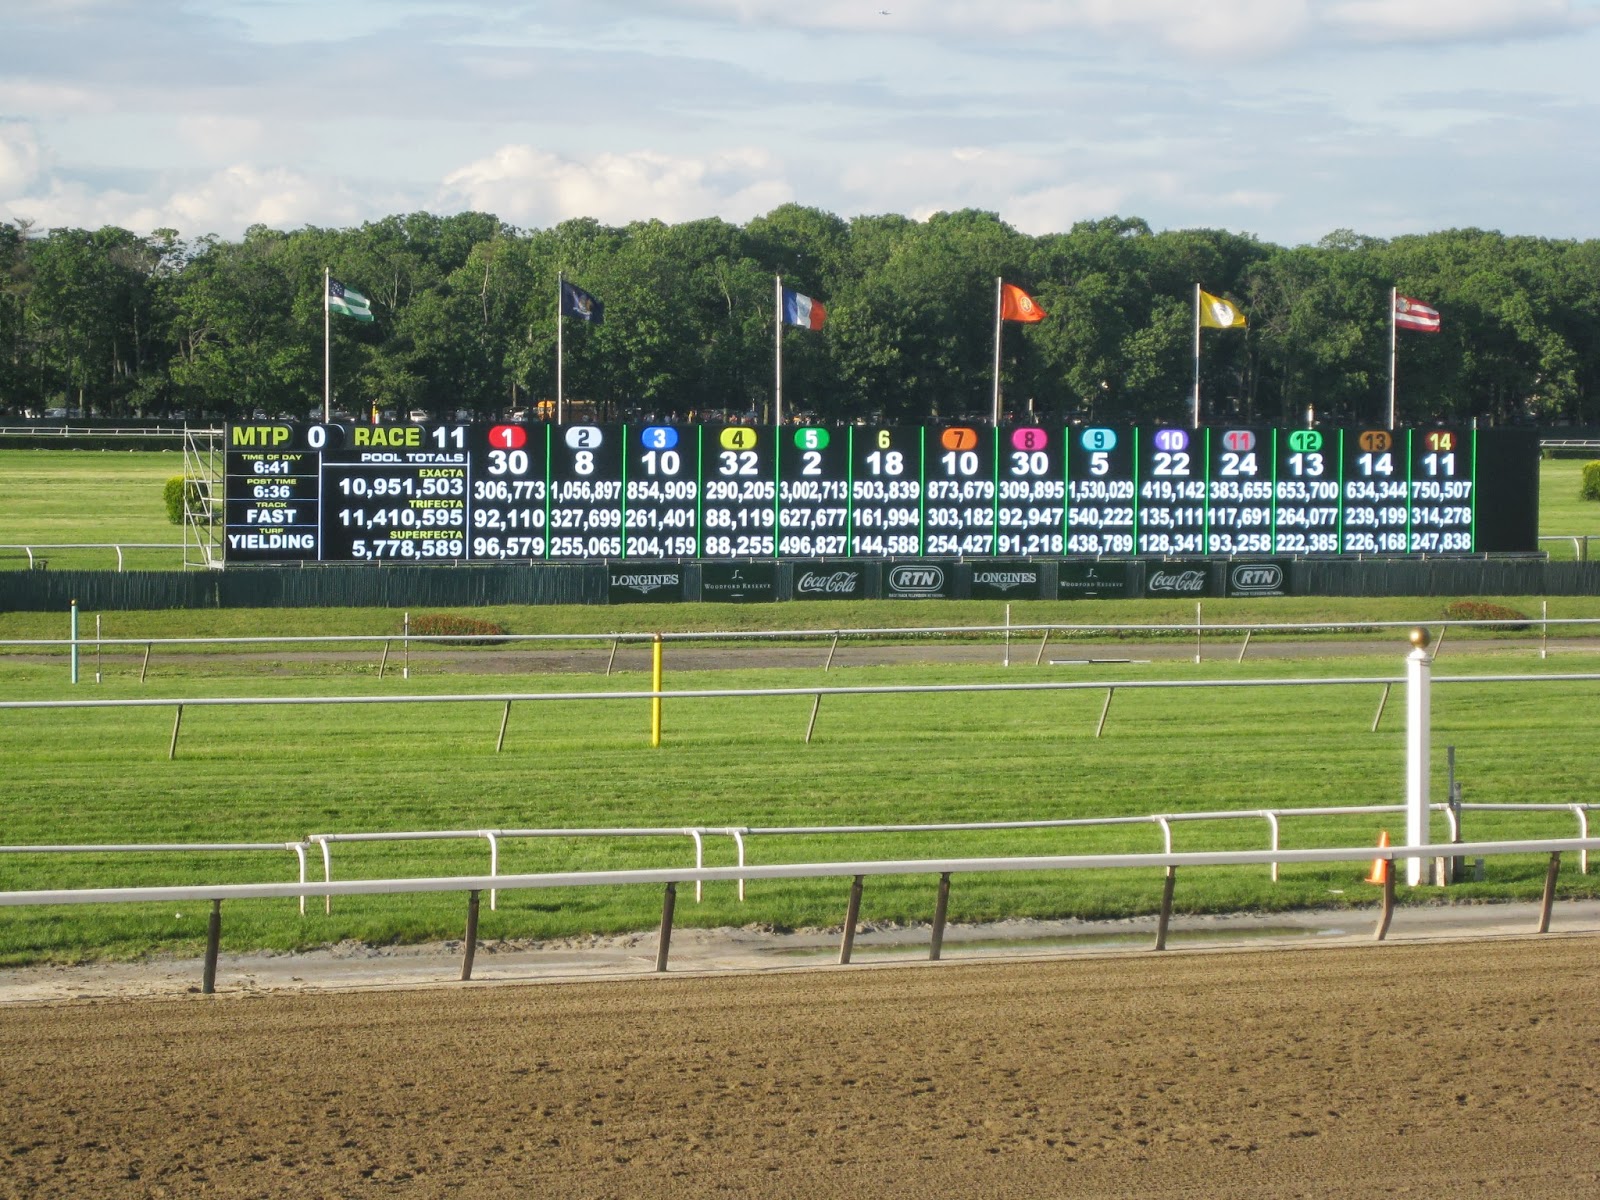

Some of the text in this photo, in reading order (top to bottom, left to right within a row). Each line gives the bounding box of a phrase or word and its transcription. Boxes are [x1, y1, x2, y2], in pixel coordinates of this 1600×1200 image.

[232, 426, 326, 448] MTP 0
[354, 426, 464, 448] RACE 11
[501, 428, 512, 447] 1
[578, 429, 590, 447] 2
[653, 429, 666, 448] 3
[731, 430, 745, 448] 4
[805, 430, 818, 448] 5
[878, 430, 891, 448] 6
[953, 431, 965, 449] 7
[1024, 431, 1035, 448] 8
[1094, 431, 1105, 448] 9
[1160, 432, 1184, 450] 10
[1228, 432, 1250, 450] 11
[1295, 433, 1317, 450] 12
[1365, 433, 1386, 450] 13
[1430, 433, 1451, 451] 14
[253, 461, 289, 474] 6:41
[361, 453, 464, 463] POOL TOTALS
[487, 450, 528, 475] 30
[574, 450, 595, 475] 8
[641, 451, 680, 475] 10
[719, 451, 758, 475] 32
[802, 451, 822, 475] 2
[866, 451, 904, 475] 18
[942, 451, 979, 475] 10
[1011, 451, 1049, 475] 30
[1090, 452, 1109, 475] 5
[1153, 452, 1190, 476] 22
[1221, 452, 1258, 476] 24
[1289, 453, 1324, 476] 13
[1359, 453, 1393, 476] 14
[1424, 453, 1455, 476] 11
[418, 469, 464, 478] EXACTA
[253, 485, 291, 498] 6:36
[338, 478, 464, 499] 10,951,503
[474, 481, 546, 503] 306,773
[550, 481, 622, 503] 1,056,897
[627, 481, 697, 503] 854,909
[706, 481, 775, 503] 290,205
[779, 481, 848, 503] 3,002,713
[853, 481, 920, 503] 503,839
[928, 481, 994, 503] 873,679
[999, 481, 1064, 503] 309,895
[1068, 481, 1135, 503] 1,530,029
[1142, 481, 1206, 502] 419,142
[1210, 481, 1272, 502] 383,655
[1276, 481, 1339, 502] 653,700
[1346, 481, 1407, 502] 634,344
[1412, 481, 1472, 502] 750,507
[408, 500, 464, 508] TRIFECTA
[246, 509, 297, 523] FAST
[338, 509, 463, 529] 11,410,595
[474, 509, 545, 531] 92,110
[550, 509, 621, 531] 327,699
[625, 508, 695, 531] 261,401
[705, 508, 775, 531] 88,119
[779, 508, 847, 530] 627,677
[853, 508, 920, 530] 161,994
[928, 508, 993, 529] 303,182
[999, 508, 1064, 529] 92,947
[1068, 508, 1134, 529] 540,222
[1139, 508, 1204, 529] 135,111
[1207, 507, 1271, 529] 117,691
[1276, 507, 1338, 529] 264,077
[1345, 507, 1407, 528] 239,199
[1411, 507, 1472, 528] 314,278
[228, 534, 314, 549] YIELDING
[390, 530, 463, 540] SUPERFECTA
[927, 535, 993, 556] 254,427
[998, 535, 1063, 556] 91,218
[1068, 534, 1133, 555] 438,789
[1139, 534, 1203, 555] 128,341
[1209, 533, 1271, 555] 93,258
[1276, 533, 1338, 555] 222,385
[1345, 533, 1407, 554] 226,168
[1411, 533, 1472, 554] 247,838
[352, 540, 463, 560] 5,778,589
[473, 537, 545, 560] 96,579
[550, 536, 621, 559] 255,065
[626, 536, 697, 559] 204,159
[705, 536, 774, 558] 88,255
[779, 536, 847, 557] 496,827
[852, 535, 919, 557] 144,588
[611, 574, 679, 586] LONGINES
[899, 571, 935, 586] RTN
[973, 572, 1037, 583] LONGINES
[1241, 570, 1275, 584] RTN
